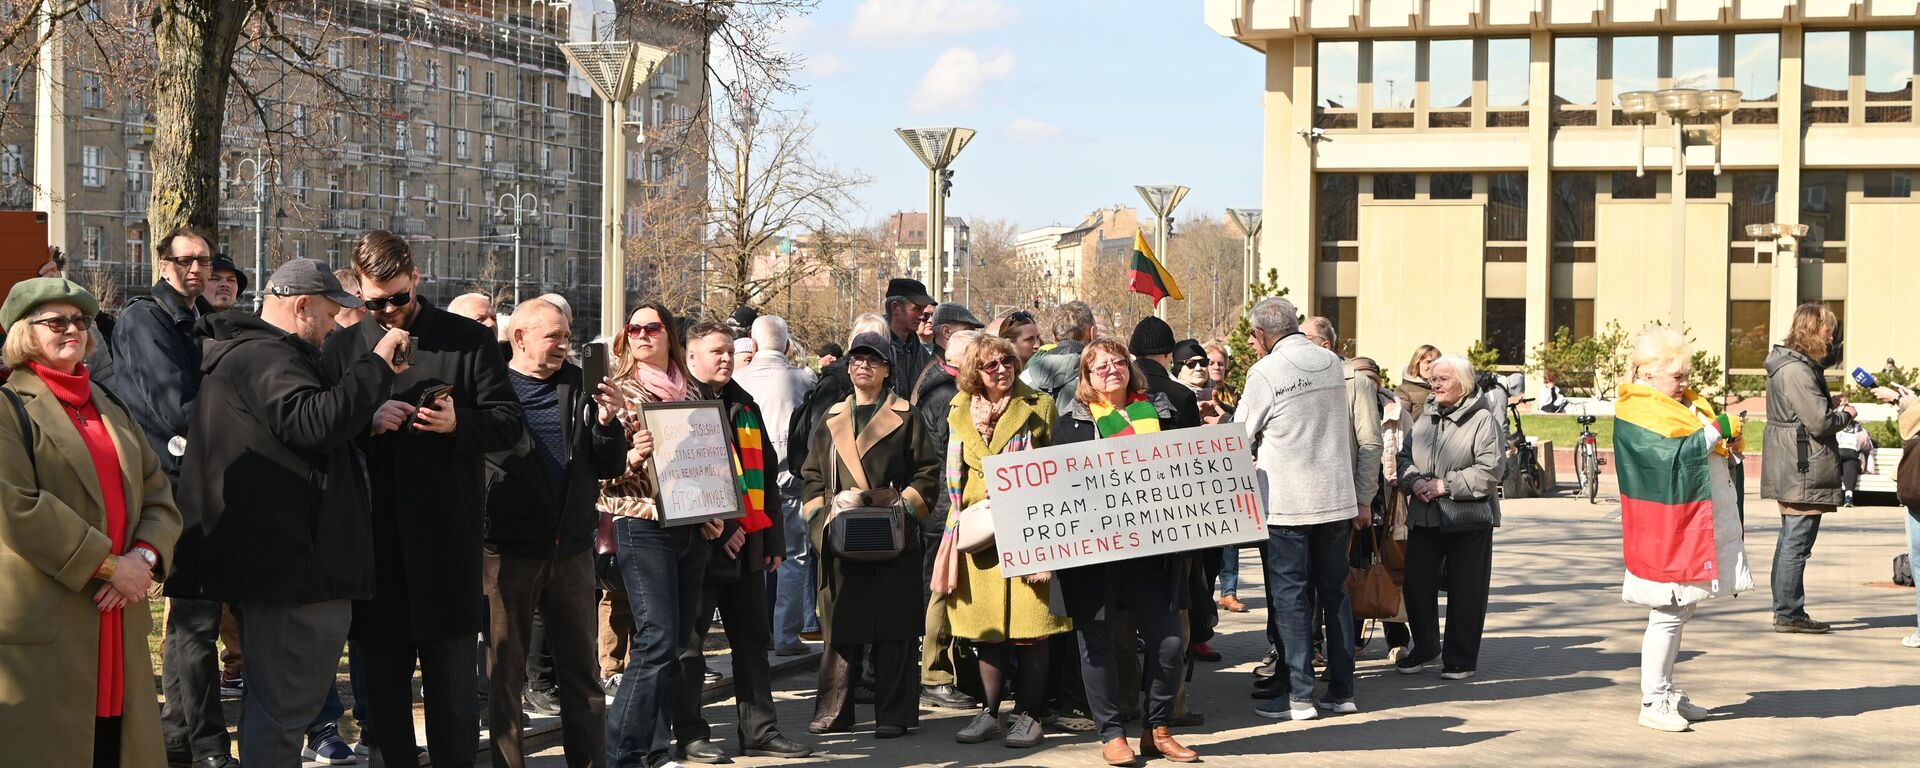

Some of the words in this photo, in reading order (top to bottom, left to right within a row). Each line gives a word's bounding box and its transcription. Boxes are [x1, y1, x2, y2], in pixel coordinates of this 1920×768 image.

[996, 459, 1059, 492] STOP
[1066, 436, 1244, 472] RAITELAITIENEI
[1170, 456, 1234, 476] MIŠKO
[1106, 475, 1255, 510] DARBUOTOJŲ
[1003, 530, 1140, 568] RUGINIENĖS
[1152, 518, 1240, 544] MOTINAI
